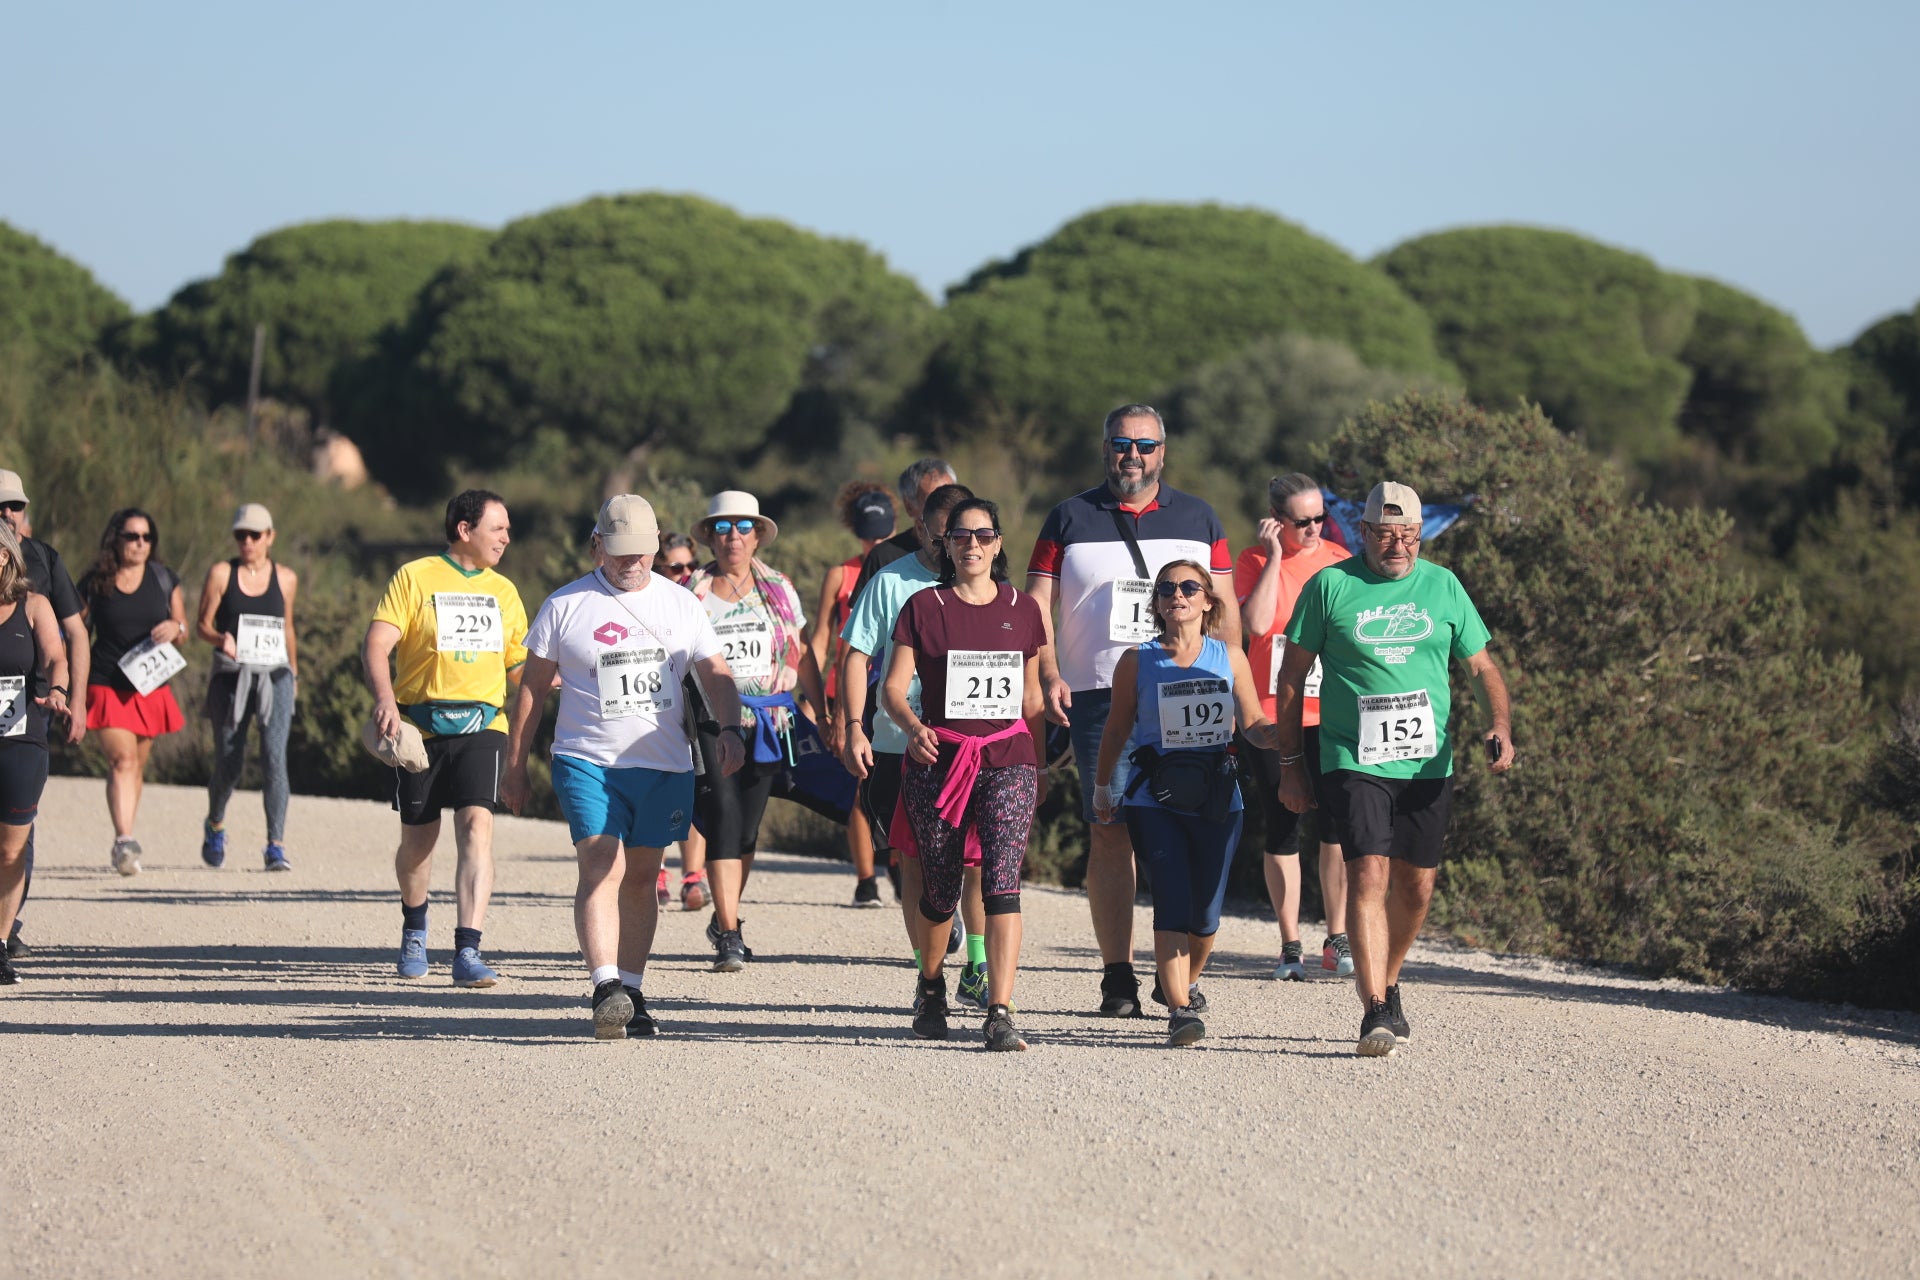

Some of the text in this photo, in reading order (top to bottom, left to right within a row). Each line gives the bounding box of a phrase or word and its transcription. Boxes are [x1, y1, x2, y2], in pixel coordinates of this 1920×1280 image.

[454, 614, 492, 633] 229
[255, 634, 279, 650] 159
[723, 639, 761, 661] 230
[619, 671, 662, 697] 168
[966, 676, 1011, 698] 213
[0, 699, 15, 718] 3
[1181, 701, 1224, 727] 192
[1378, 716, 1424, 743] 152
